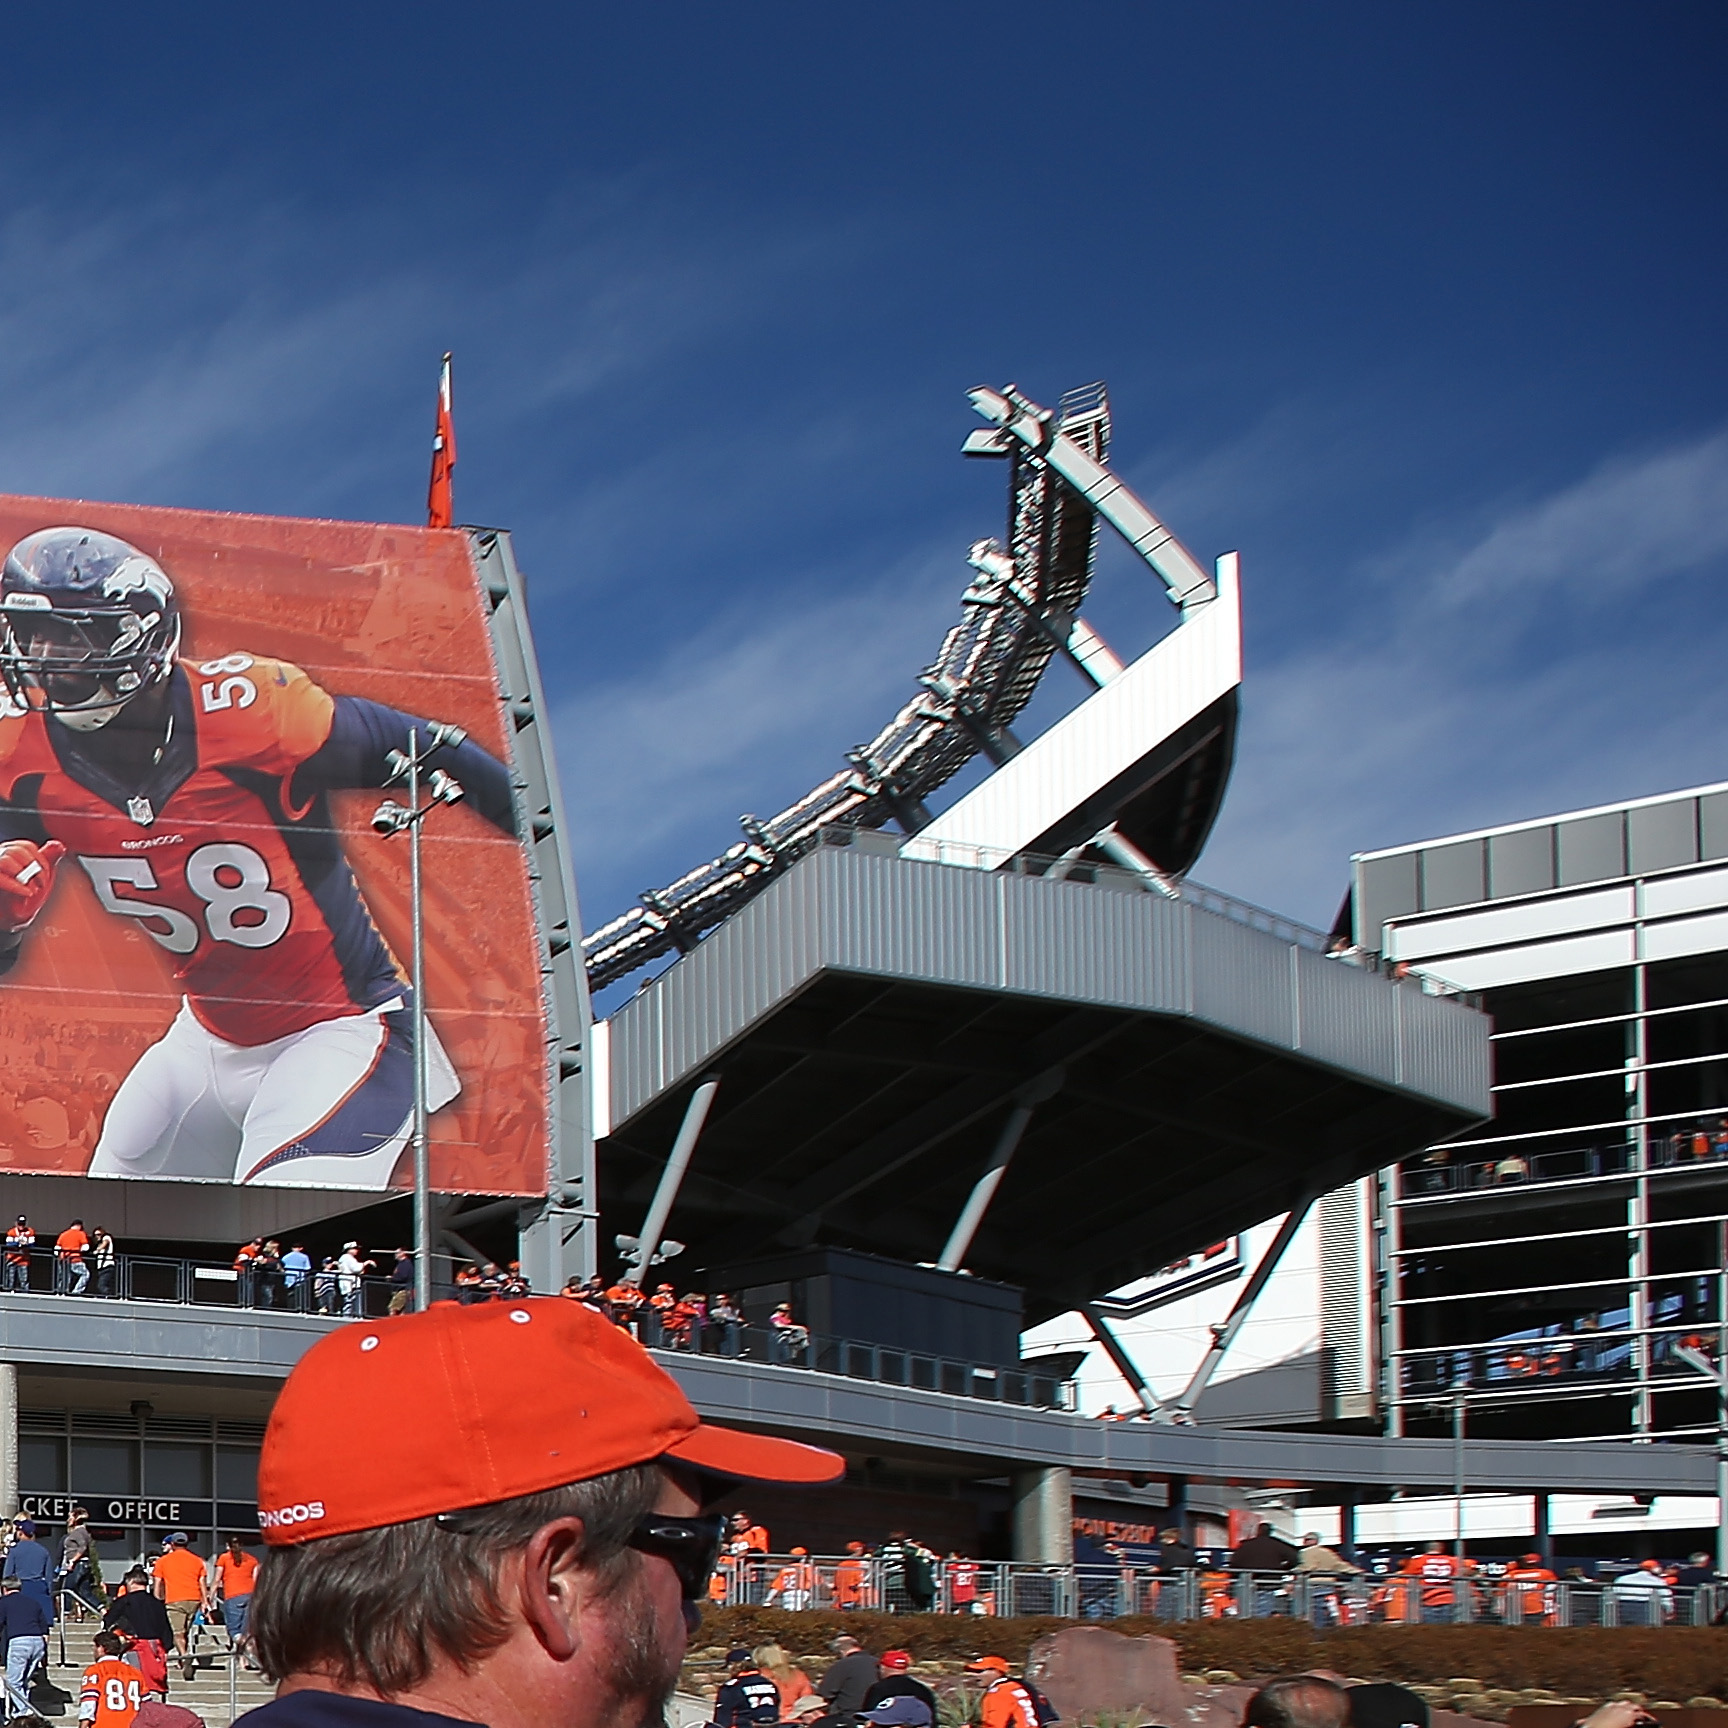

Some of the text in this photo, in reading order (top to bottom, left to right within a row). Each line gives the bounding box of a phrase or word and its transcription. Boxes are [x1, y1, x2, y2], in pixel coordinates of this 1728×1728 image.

[198, 654, 258, 713] 58
[121, 833, 184, 850] BRONCOS
[76, 842, 294, 955] 58
[20, 1497, 78, 1517] CKET
[107, 1500, 181, 1521] OFFICE
[257, 1501, 326, 1528] ONCOS
[105, 1678, 141, 1712] 84
